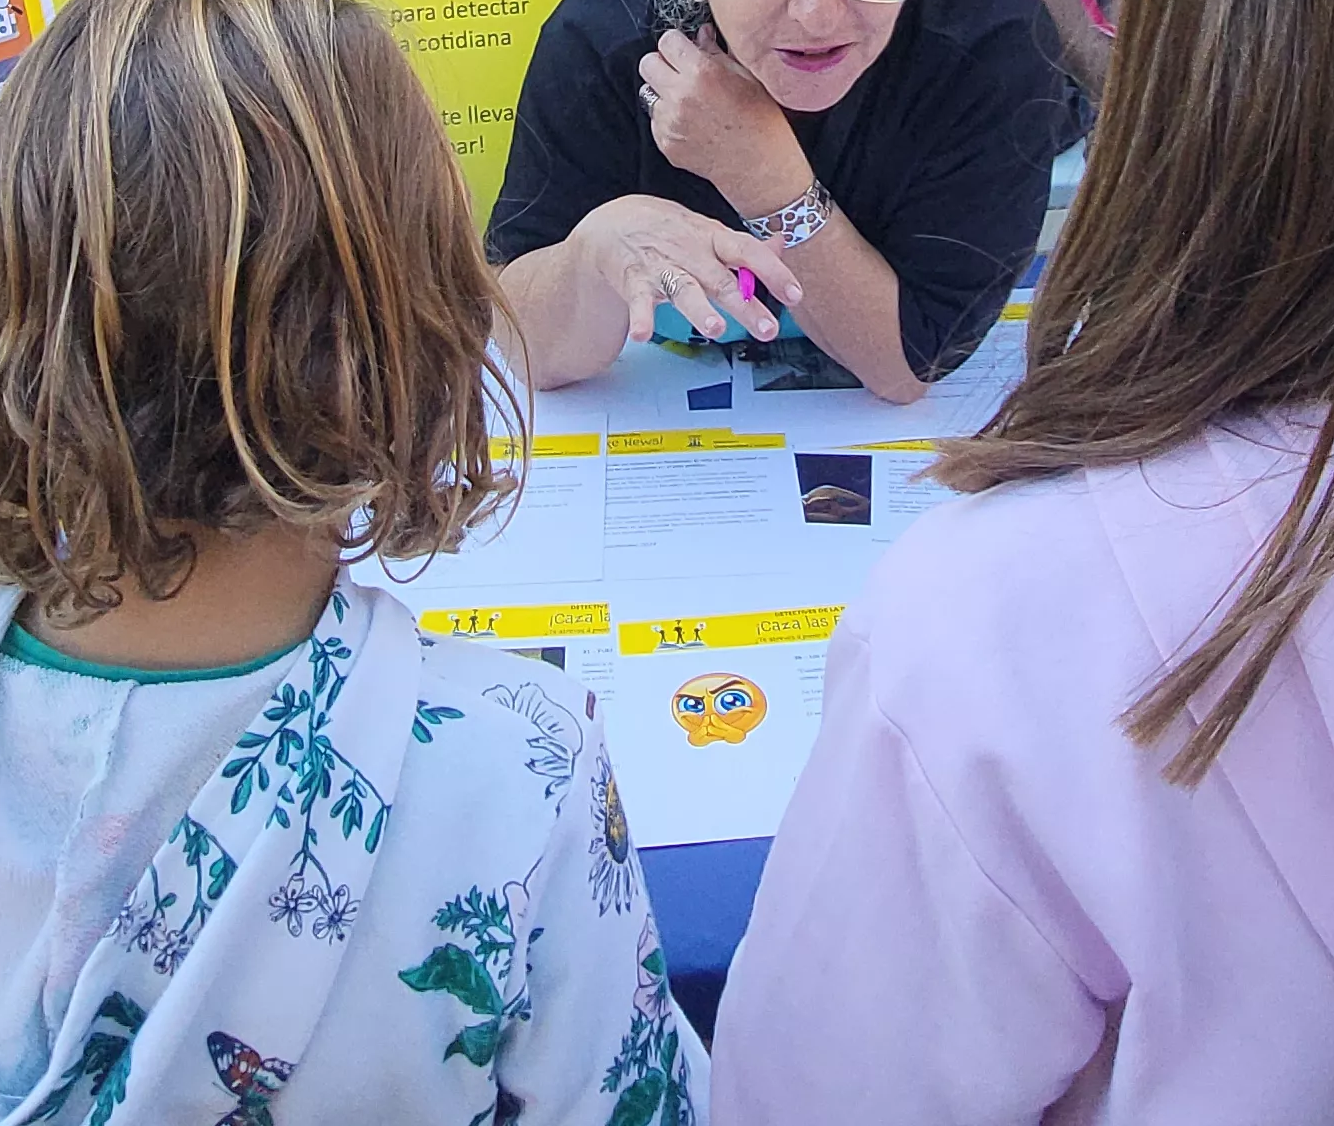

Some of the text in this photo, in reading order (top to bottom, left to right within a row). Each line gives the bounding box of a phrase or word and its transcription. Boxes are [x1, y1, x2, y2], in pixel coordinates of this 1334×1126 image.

[391, 0, 530, 27] para detectar
[418, 30, 512, 52] cotidiana
[442, 109, 462, 126] te
[600, 609, 611, 623] la
[756, 615, 829, 636] ¡Caza las
